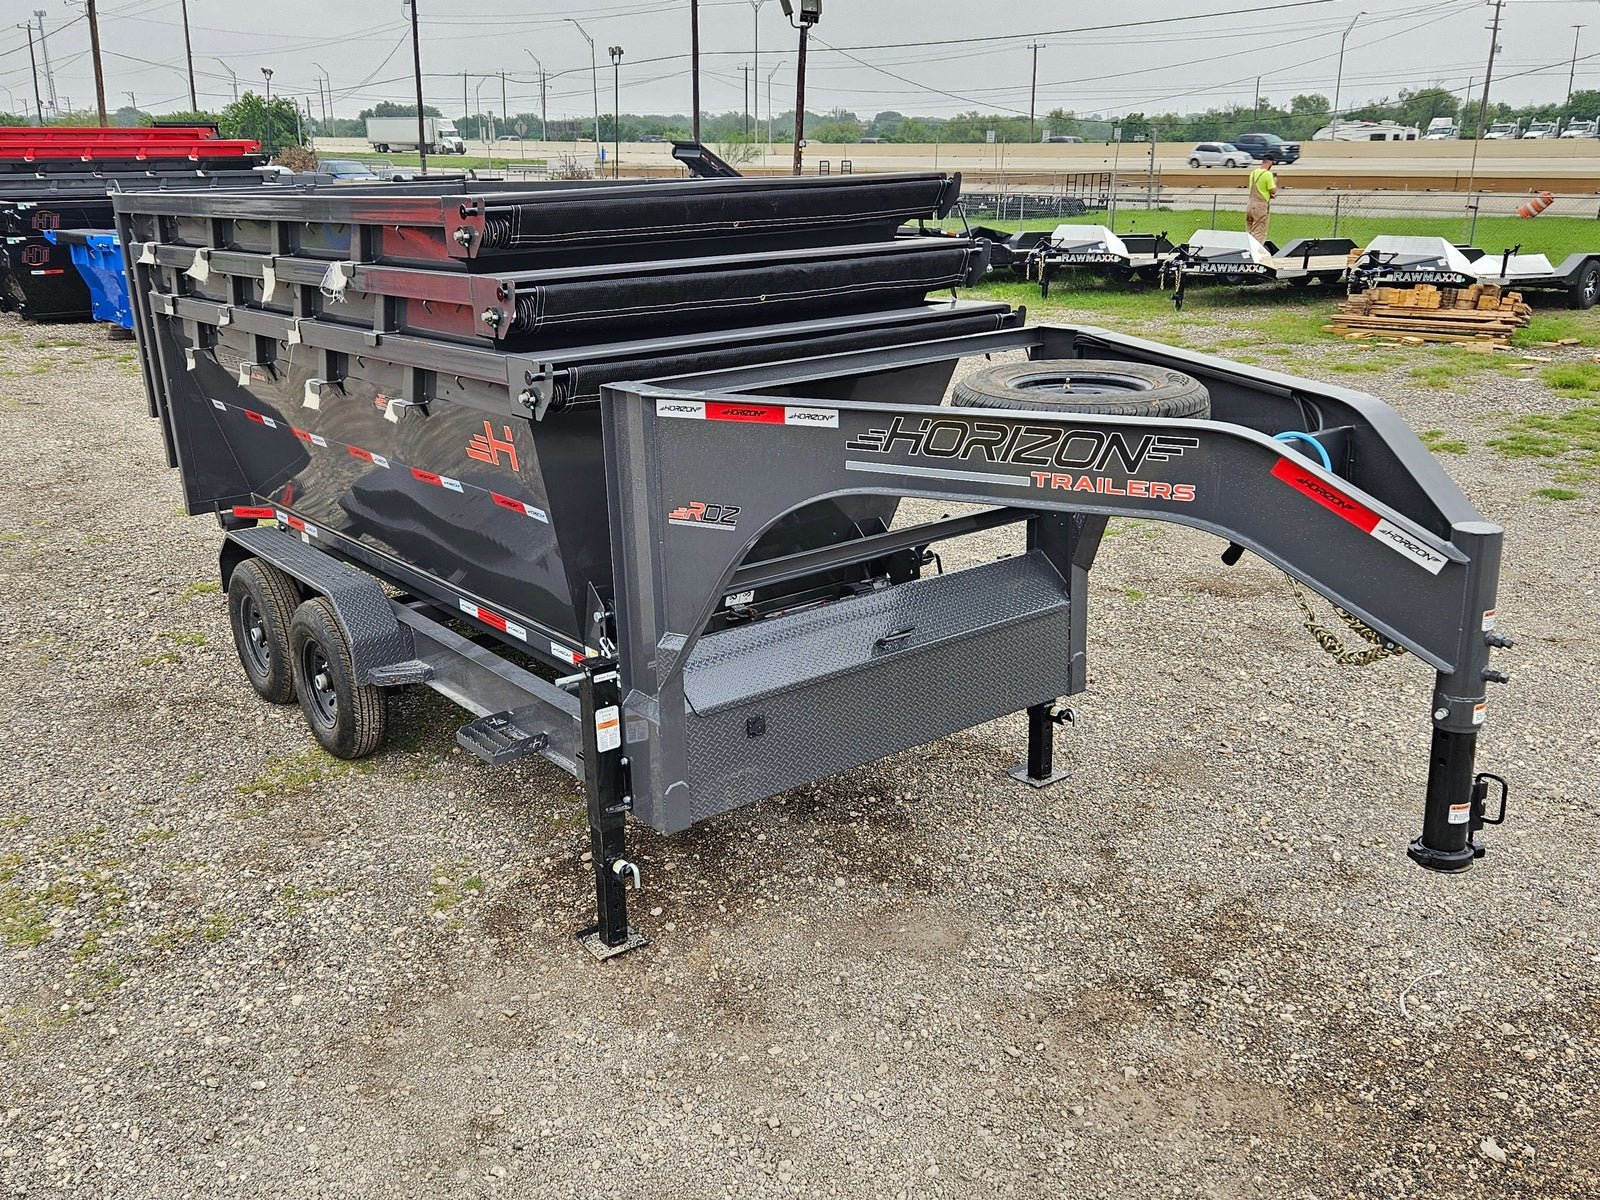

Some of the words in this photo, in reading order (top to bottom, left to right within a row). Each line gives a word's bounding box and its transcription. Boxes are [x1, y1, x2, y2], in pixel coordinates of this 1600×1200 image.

[1061, 253, 1114, 263] RAWMAXX
[1201, 263, 1259, 273] RAWMAXX
[1393, 271, 1457, 282] RAWMAXX
[662, 404, 699, 413] HORIZON
[725, 408, 763, 418] HORIZON
[792, 412, 831, 422] HORIZON
[881, 416, 1154, 475] HORIZON
[1030, 470, 1196, 501] TRAILERS
[1301, 477, 1350, 510] HORIZON
[685, 501, 742, 525] RDZ
[1384, 528, 1434, 562] HORIZON
